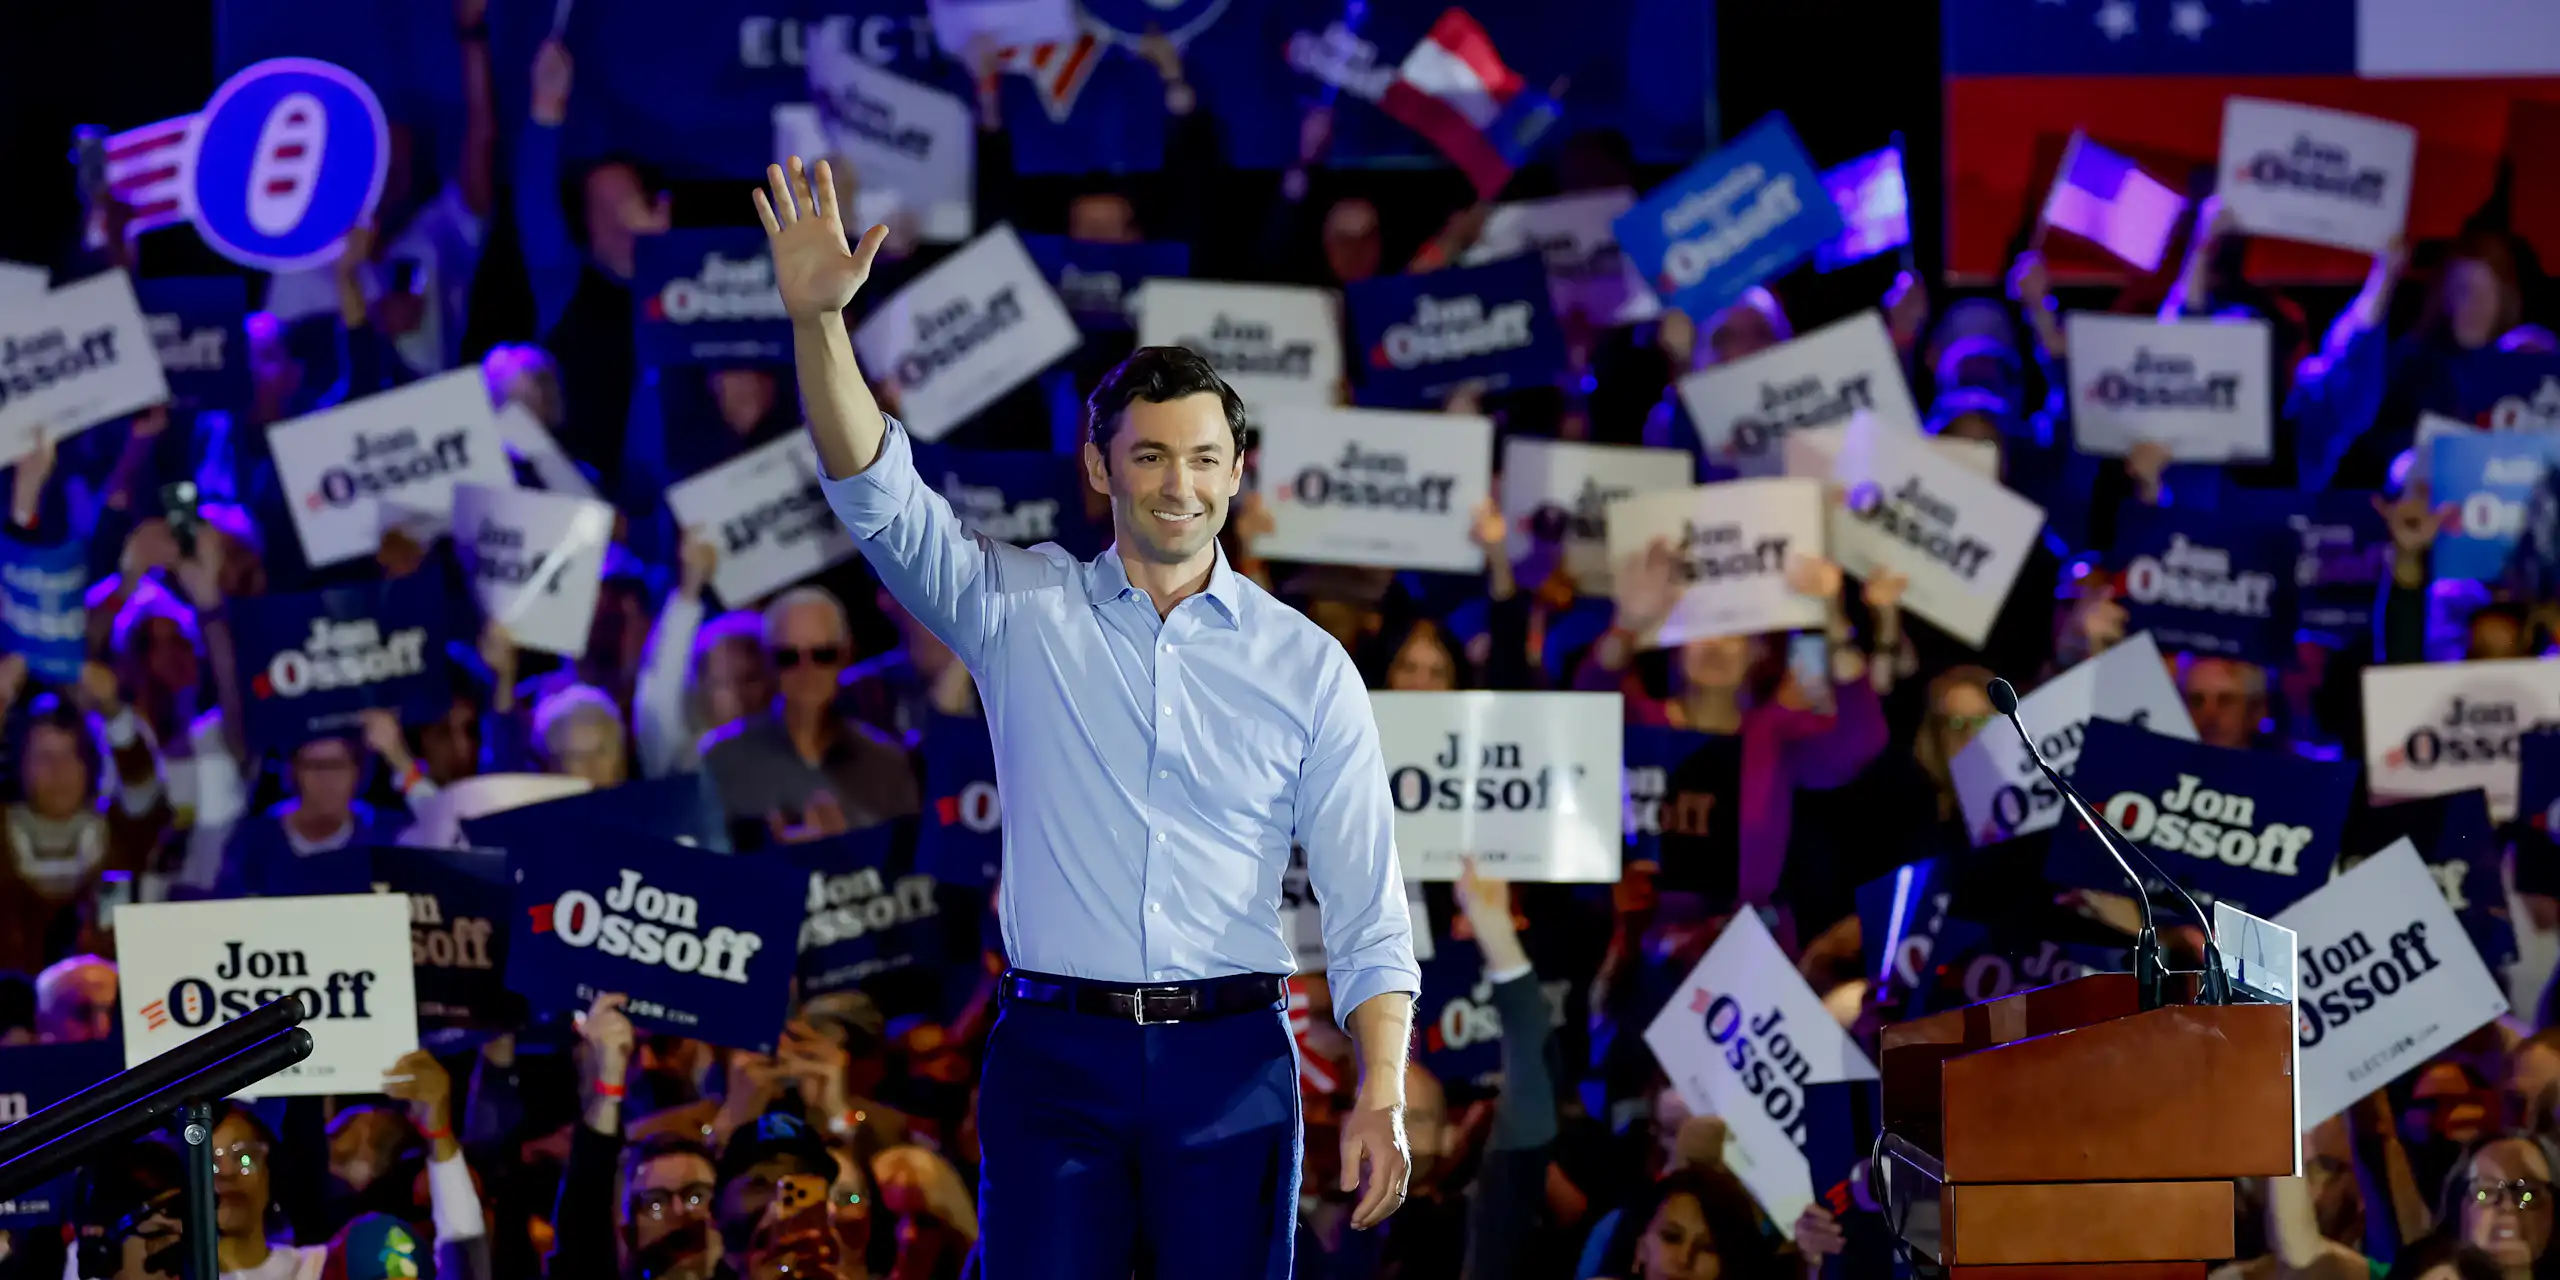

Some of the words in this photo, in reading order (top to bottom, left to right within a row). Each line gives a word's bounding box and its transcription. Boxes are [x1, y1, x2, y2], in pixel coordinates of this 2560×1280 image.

[2102, 790, 2314, 877] Ossoff
[2161, 772, 2255, 829] Jon
[605, 867, 699, 930] Jon
[797, 872, 941, 955] ssoff
[215, 940, 310, 980] Jon
[553, 889, 763, 984] Ossoff
[2299, 928, 2377, 990] Jon
[1750, 1004, 1814, 1086] Jon
